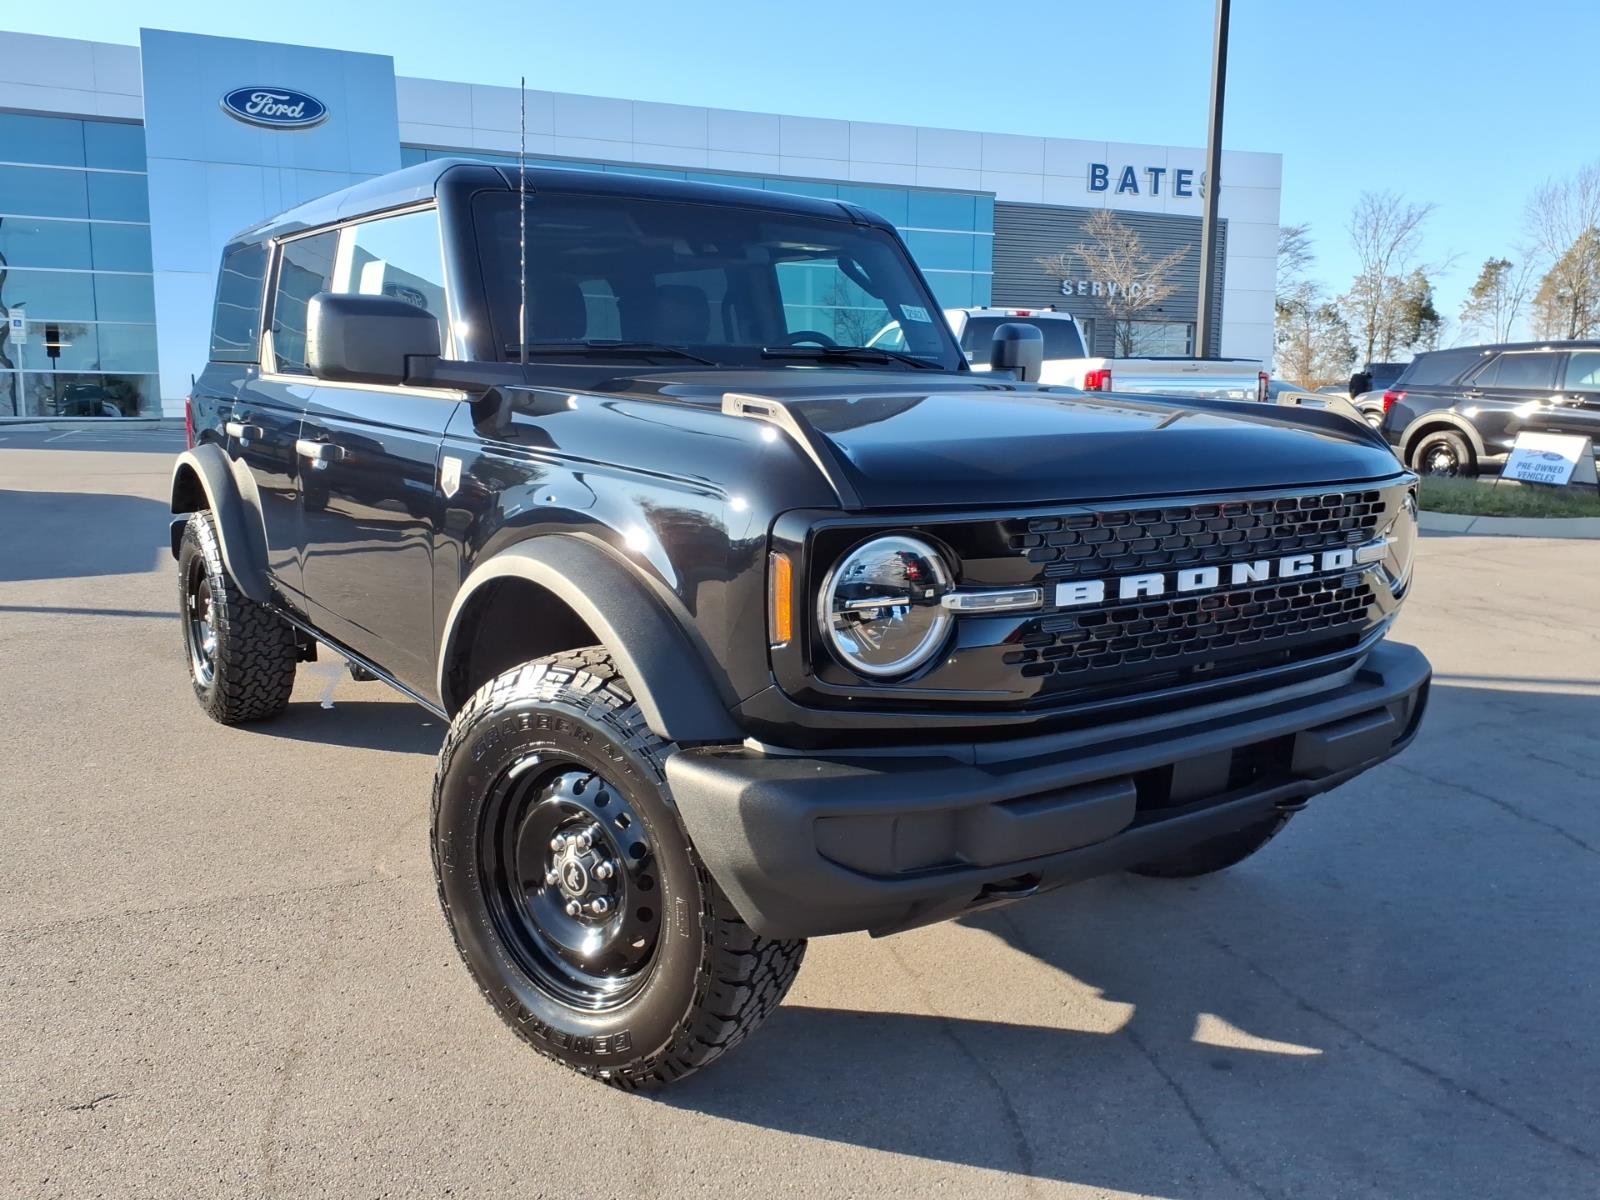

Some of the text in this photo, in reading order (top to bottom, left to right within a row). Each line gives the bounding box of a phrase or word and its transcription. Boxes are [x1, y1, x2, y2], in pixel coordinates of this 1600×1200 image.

[245, 91, 305, 118] Ford
[1516, 461, 1565, 474] PRE-OWNED
[1517, 470, 1556, 482] VEHICLES
[1055, 548, 1354, 607] BRONCO
[471, 712, 594, 762] GRABBER
